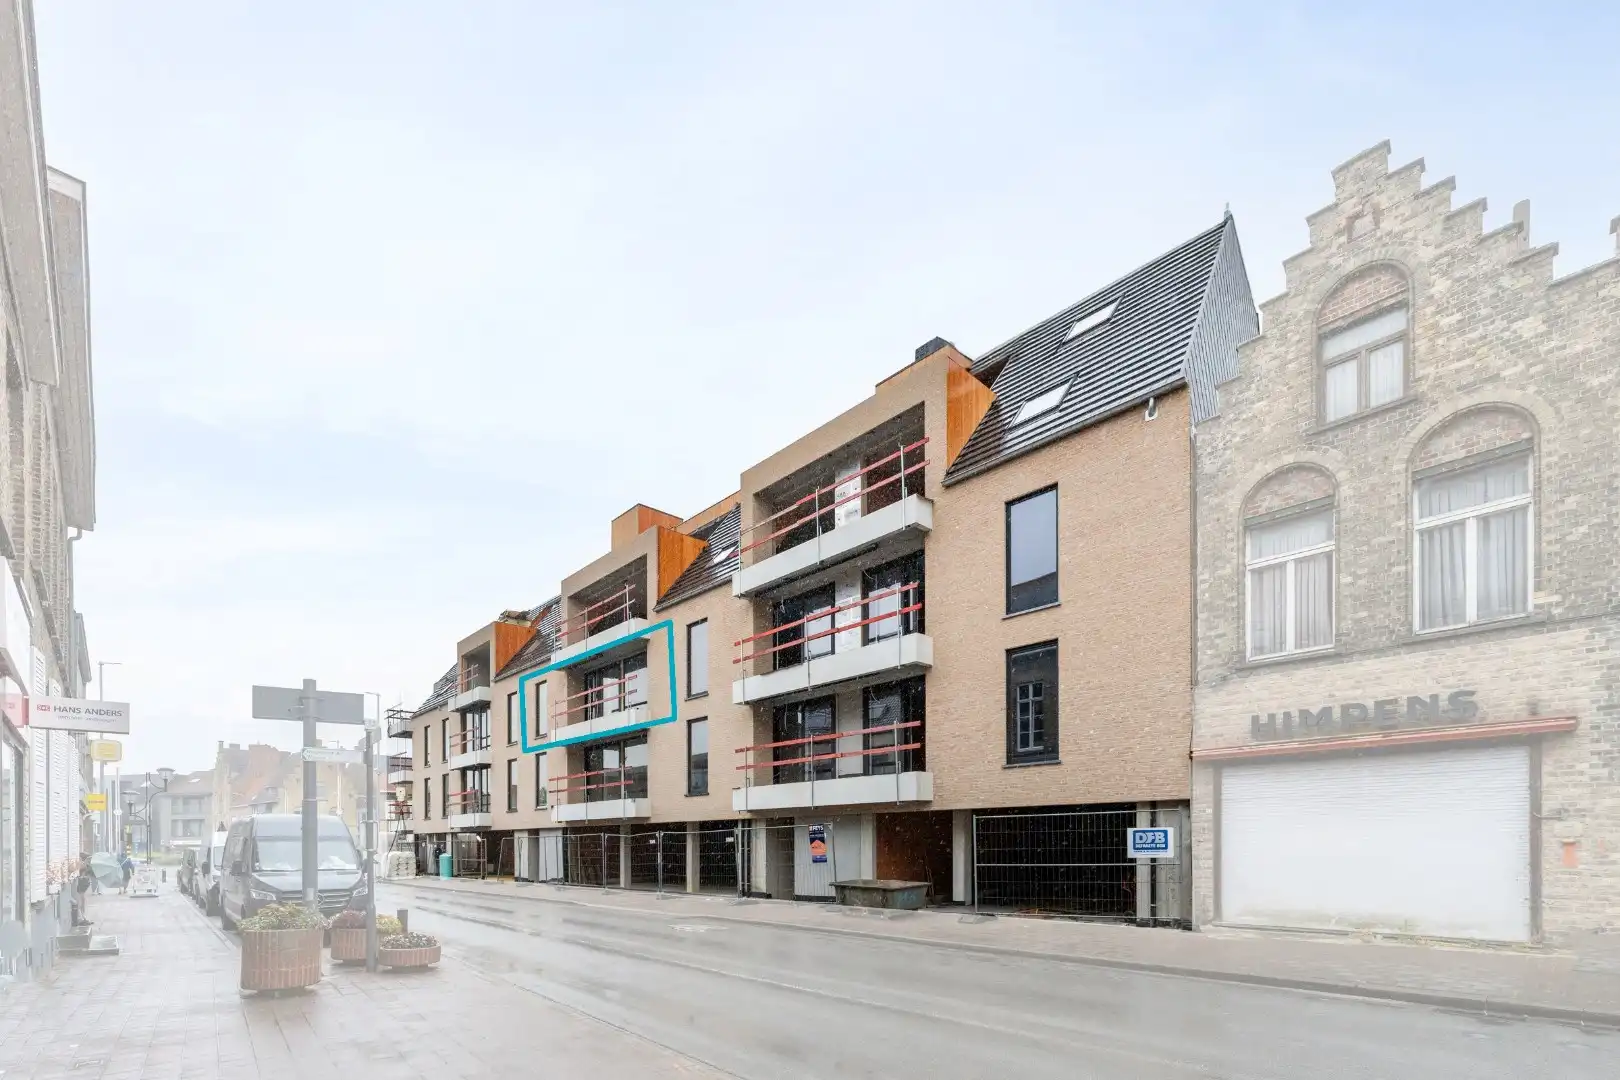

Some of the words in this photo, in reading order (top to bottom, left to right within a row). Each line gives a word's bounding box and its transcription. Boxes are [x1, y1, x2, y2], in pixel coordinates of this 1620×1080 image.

[53, 703, 82, 714] HANS
[84, 707, 122, 717] ANDERS
[1250, 690, 1480, 742] HIMPENS
[1135, 832, 1166, 844] DFB
